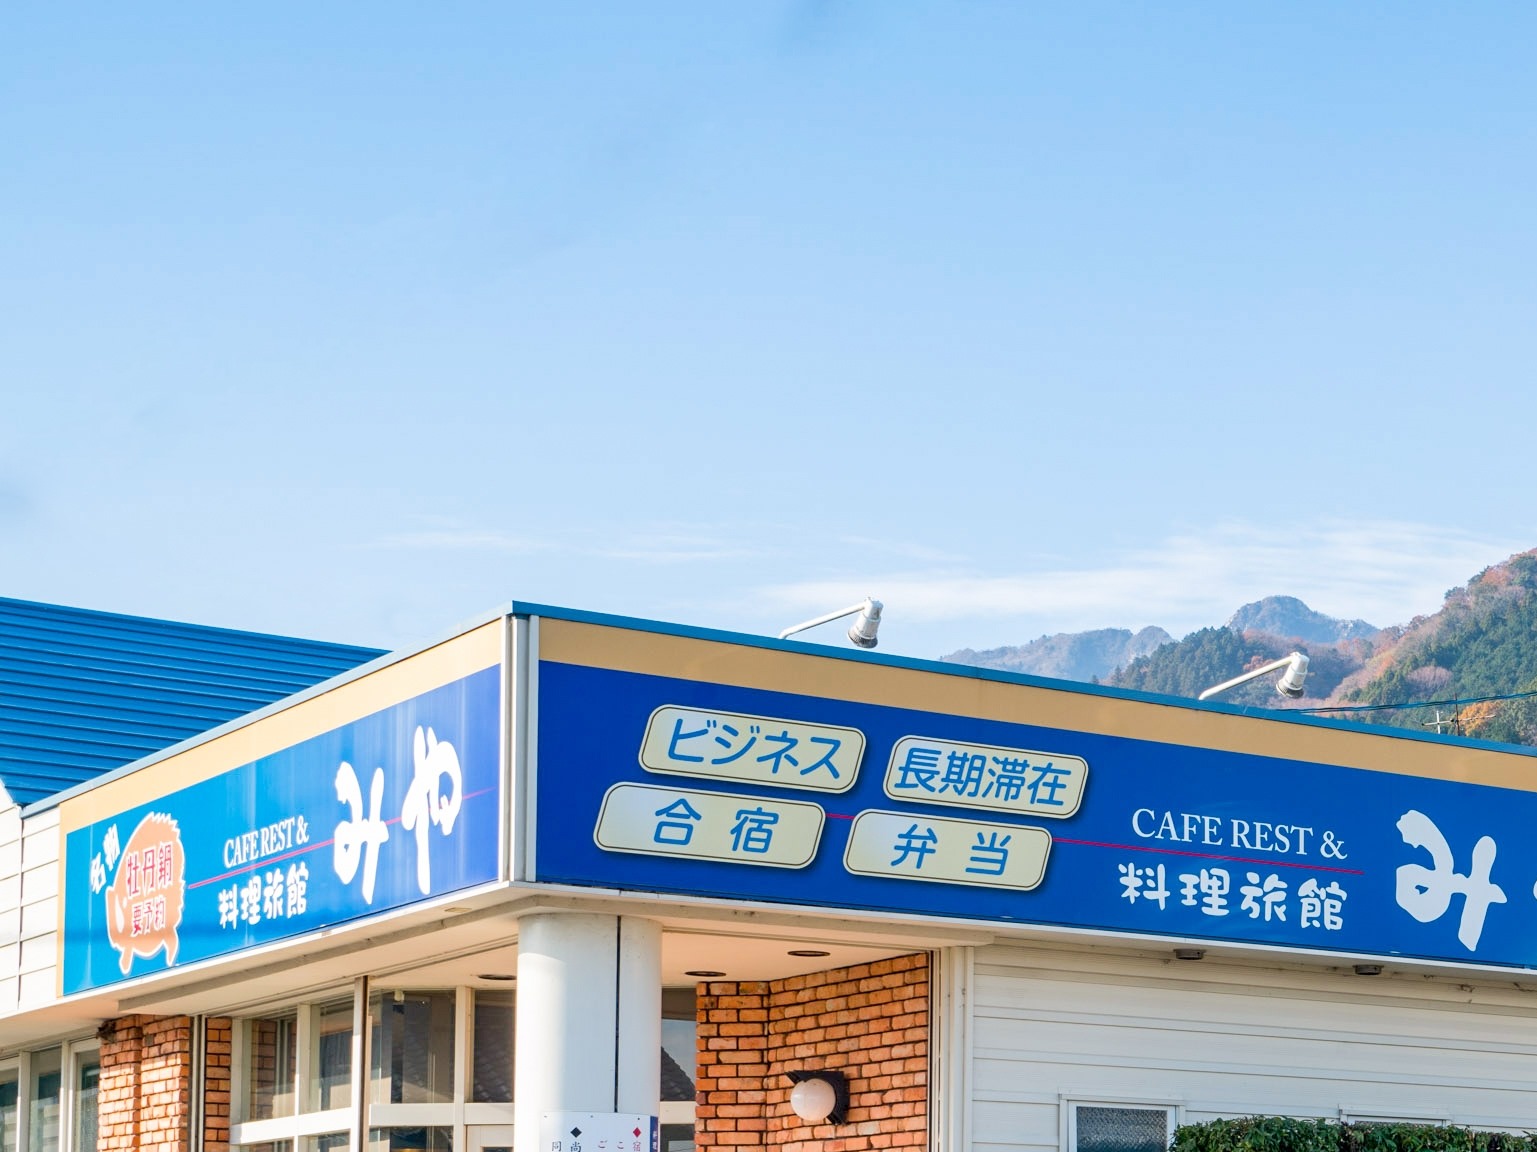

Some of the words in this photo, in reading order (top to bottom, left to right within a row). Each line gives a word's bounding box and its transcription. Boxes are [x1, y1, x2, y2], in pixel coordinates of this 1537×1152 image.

[666, 718, 842, 780] ビジネス
[895, 747, 1072, 807] 長期滞在
[223, 836, 259, 869] CAFE
[260, 819, 294, 853] REST
[295, 815, 310, 845] &
[334, 725, 463, 904] みや
[653, 798, 780, 854] 合宿
[1132, 808, 1221, 844] CAFE
[1231, 819, 1312, 856] REST
[1320, 831, 1347, 860] &
[126, 842, 173, 899] 牡丹鍋
[891, 824, 1012, 876] 弁当
[131, 896, 166, 937] 要予約
[218, 861, 308, 930] 料理旅館
[1117, 862, 1347, 931] 料理旅館
